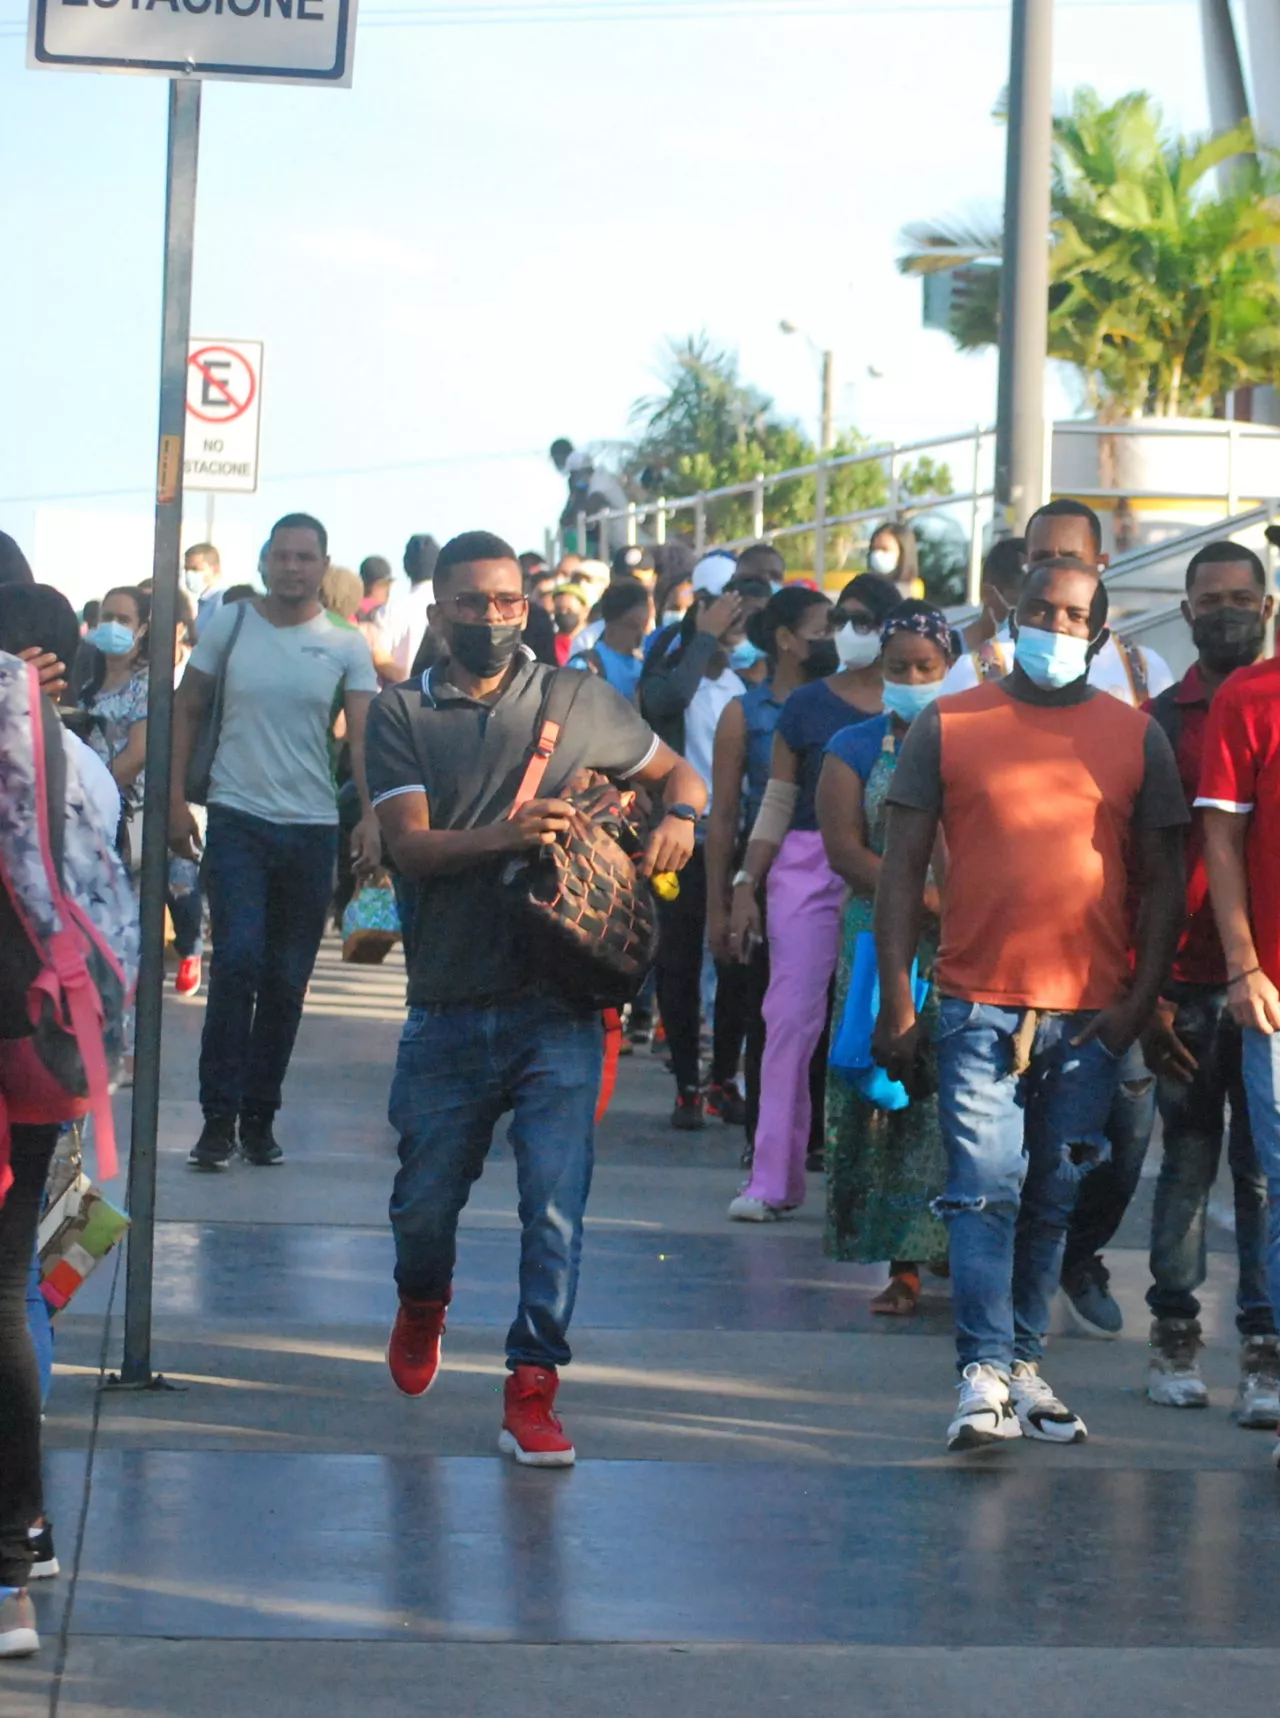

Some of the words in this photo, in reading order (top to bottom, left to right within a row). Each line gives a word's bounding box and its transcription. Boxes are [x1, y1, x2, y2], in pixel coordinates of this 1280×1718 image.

[202, 361, 231, 406] E
[204, 439, 224, 453] NO
[184, 460, 251, 477] STACIONE
